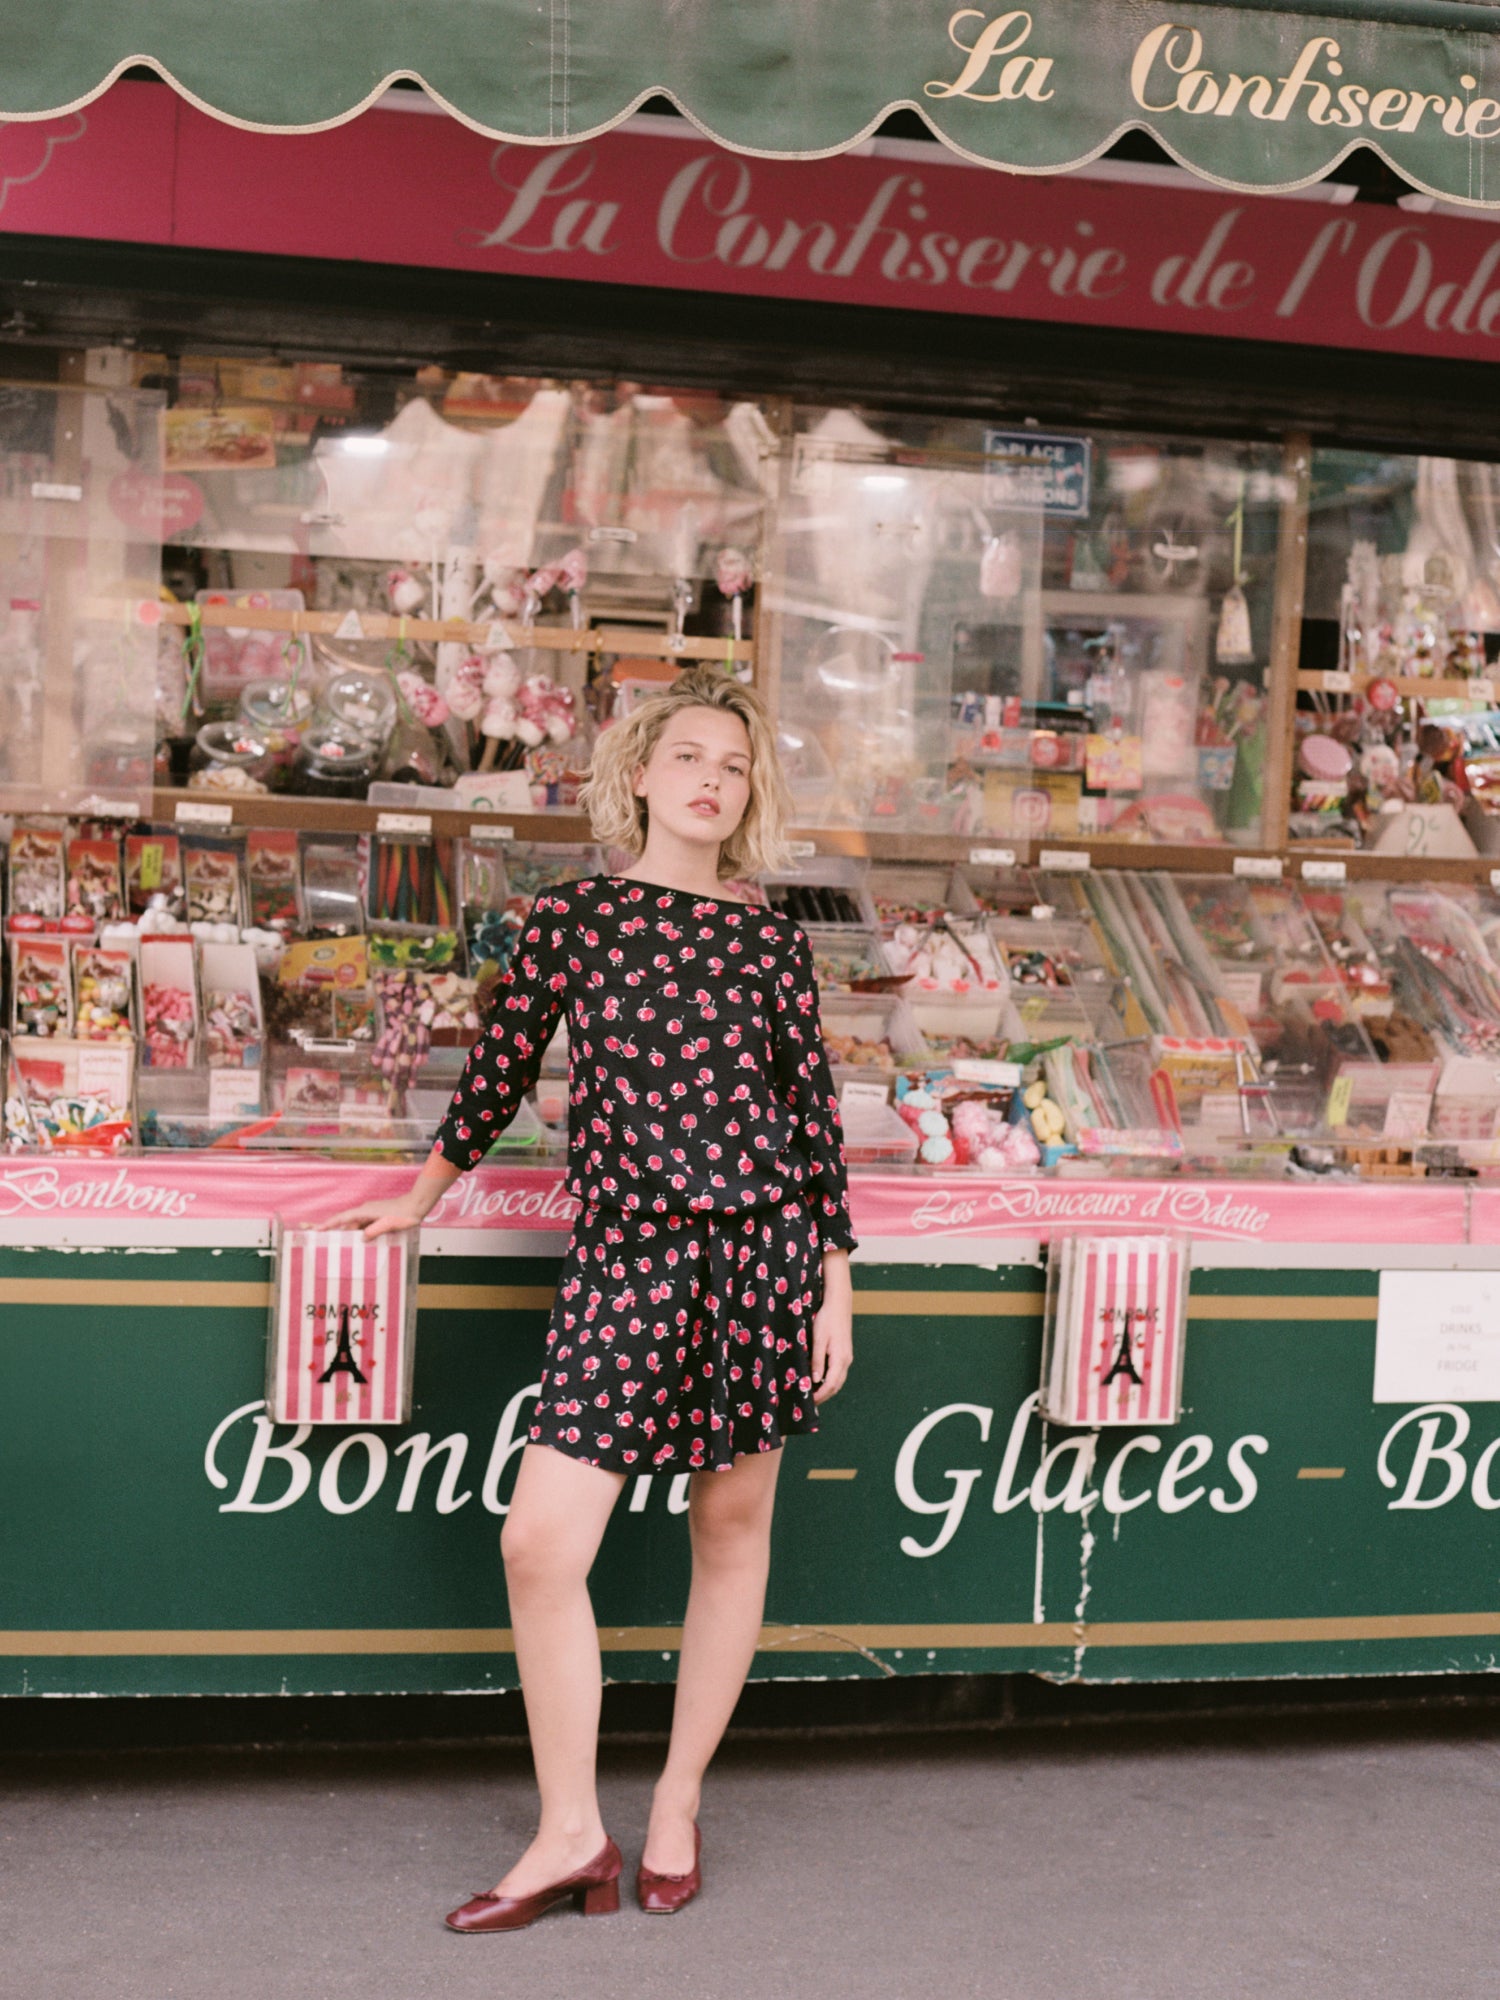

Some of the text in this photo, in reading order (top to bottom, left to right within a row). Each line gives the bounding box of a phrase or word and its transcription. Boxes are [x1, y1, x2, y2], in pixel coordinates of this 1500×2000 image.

[923, 8, 1500, 138] La Confiserie
[457, 142, 621, 255] La
[657, 153, 1126, 299] Confiserie
[1150, 208, 1256, 311] de
[0, 1166, 196, 1217] Bonbons
[911, 1183, 1270, 1233] Les Douceurs d'Odette
[1440, 1322, 1482, 1335] DRINKS
[1437, 1360, 1479, 1372] FRIDGE
[894, 1389, 1269, 1558] Glaces
